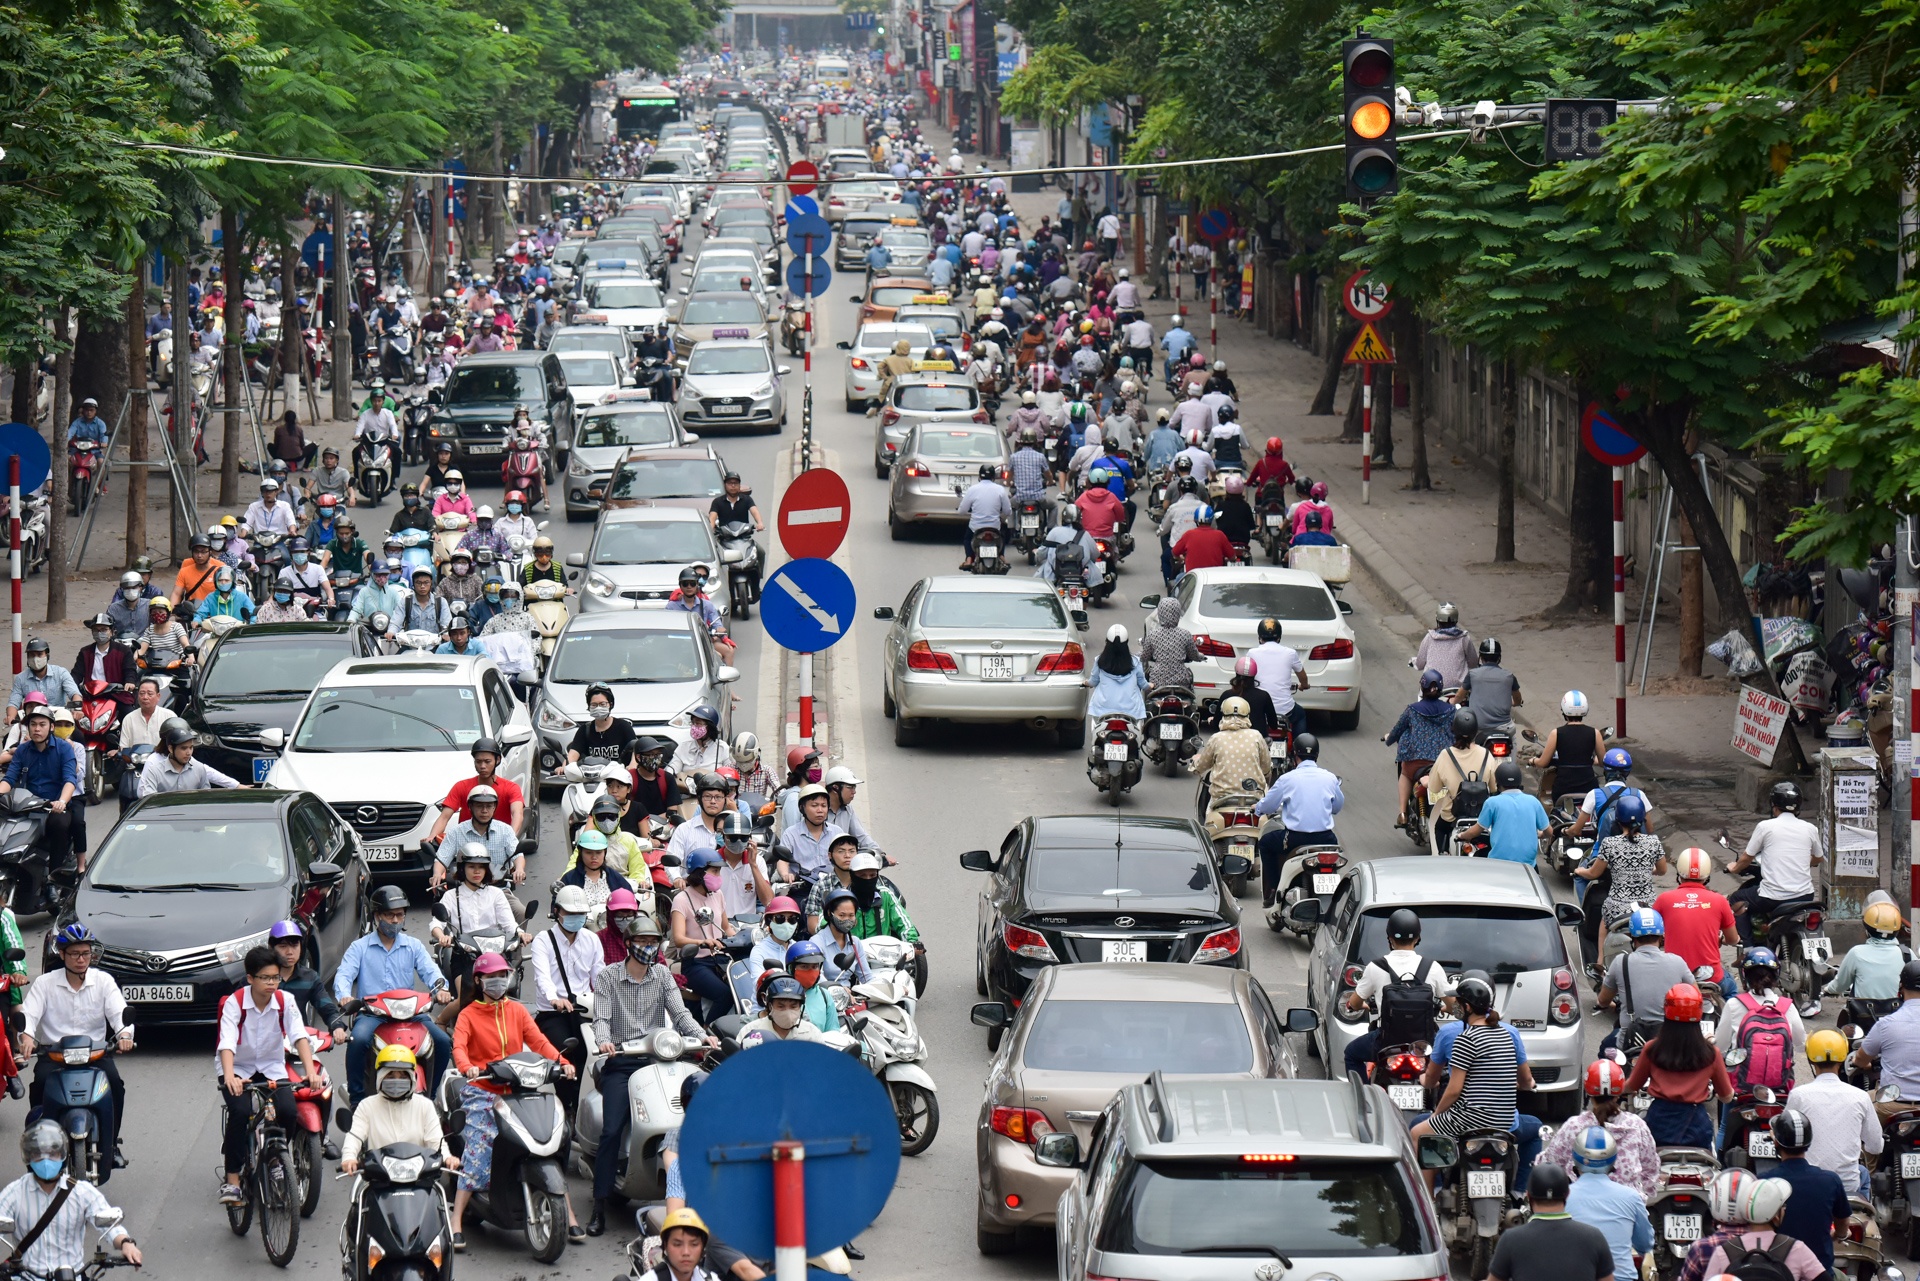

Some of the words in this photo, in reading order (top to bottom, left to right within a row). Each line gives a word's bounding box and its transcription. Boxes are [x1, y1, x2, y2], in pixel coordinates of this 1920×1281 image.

[999, 61, 1013, 69] Pet
[989, 658, 1006, 668] 19A
[983, 668, 1012, 678] 121.75
[1161, 731, 1182, 739] 556.28
[1107, 744, 1124, 752] 29-G1
[1271, 749, 1285, 757] 2.18
[1106, 752, 1126, 760] 120.10
[363, 848, 398, 860] 072.53
[1317, 875, 1337, 884] 29-H1
[1112, 943, 1136, 956] 30E
[123, 986, 191, 1001] 30A-846.64
[1392, 1097, 1420, 1108] 19.31
[1751, 1145, 1777, 1156] 986.6
[1904, 1166, 1920, 1177] 696
[1473, 1173, 1499, 1184] 29-E1
[1470, 1185, 1503, 1196] 631.88
[1671, 1216, 1696, 1227] 14-B1
[1667, 1227, 1700, 1239] 412.07
